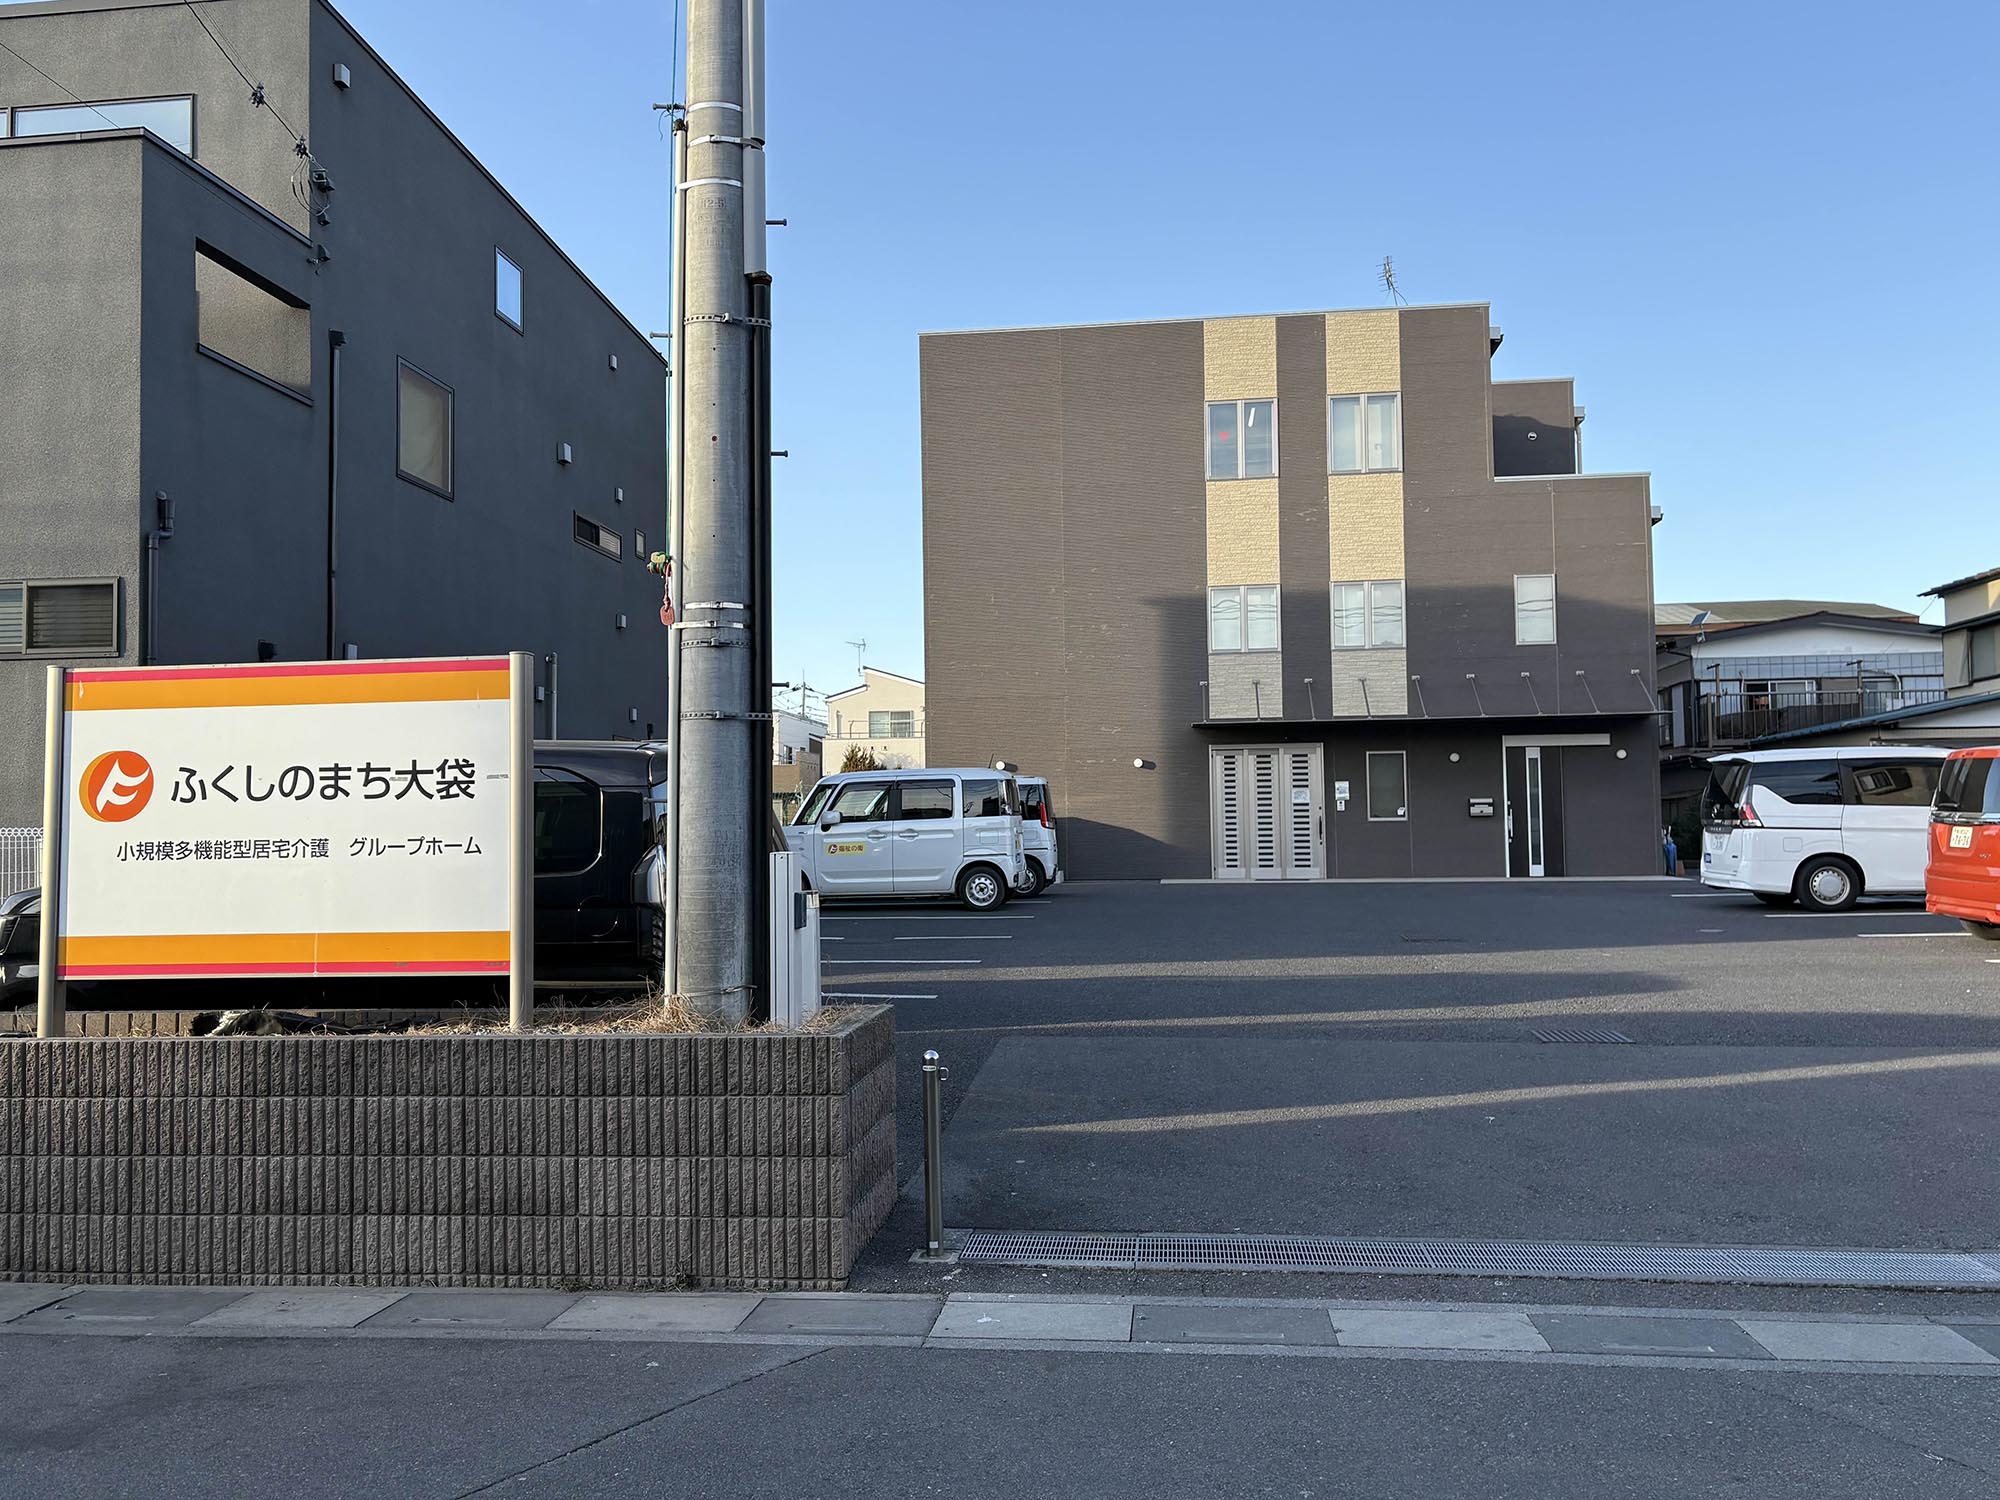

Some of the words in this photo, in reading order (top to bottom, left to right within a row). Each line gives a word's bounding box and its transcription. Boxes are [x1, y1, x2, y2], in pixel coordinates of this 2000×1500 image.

[170, 758, 476, 804] ふくしのまち大袋
[116, 838, 329, 862] 小規模多機能型居宅介護
[349, 835, 482, 857] グループホーム
